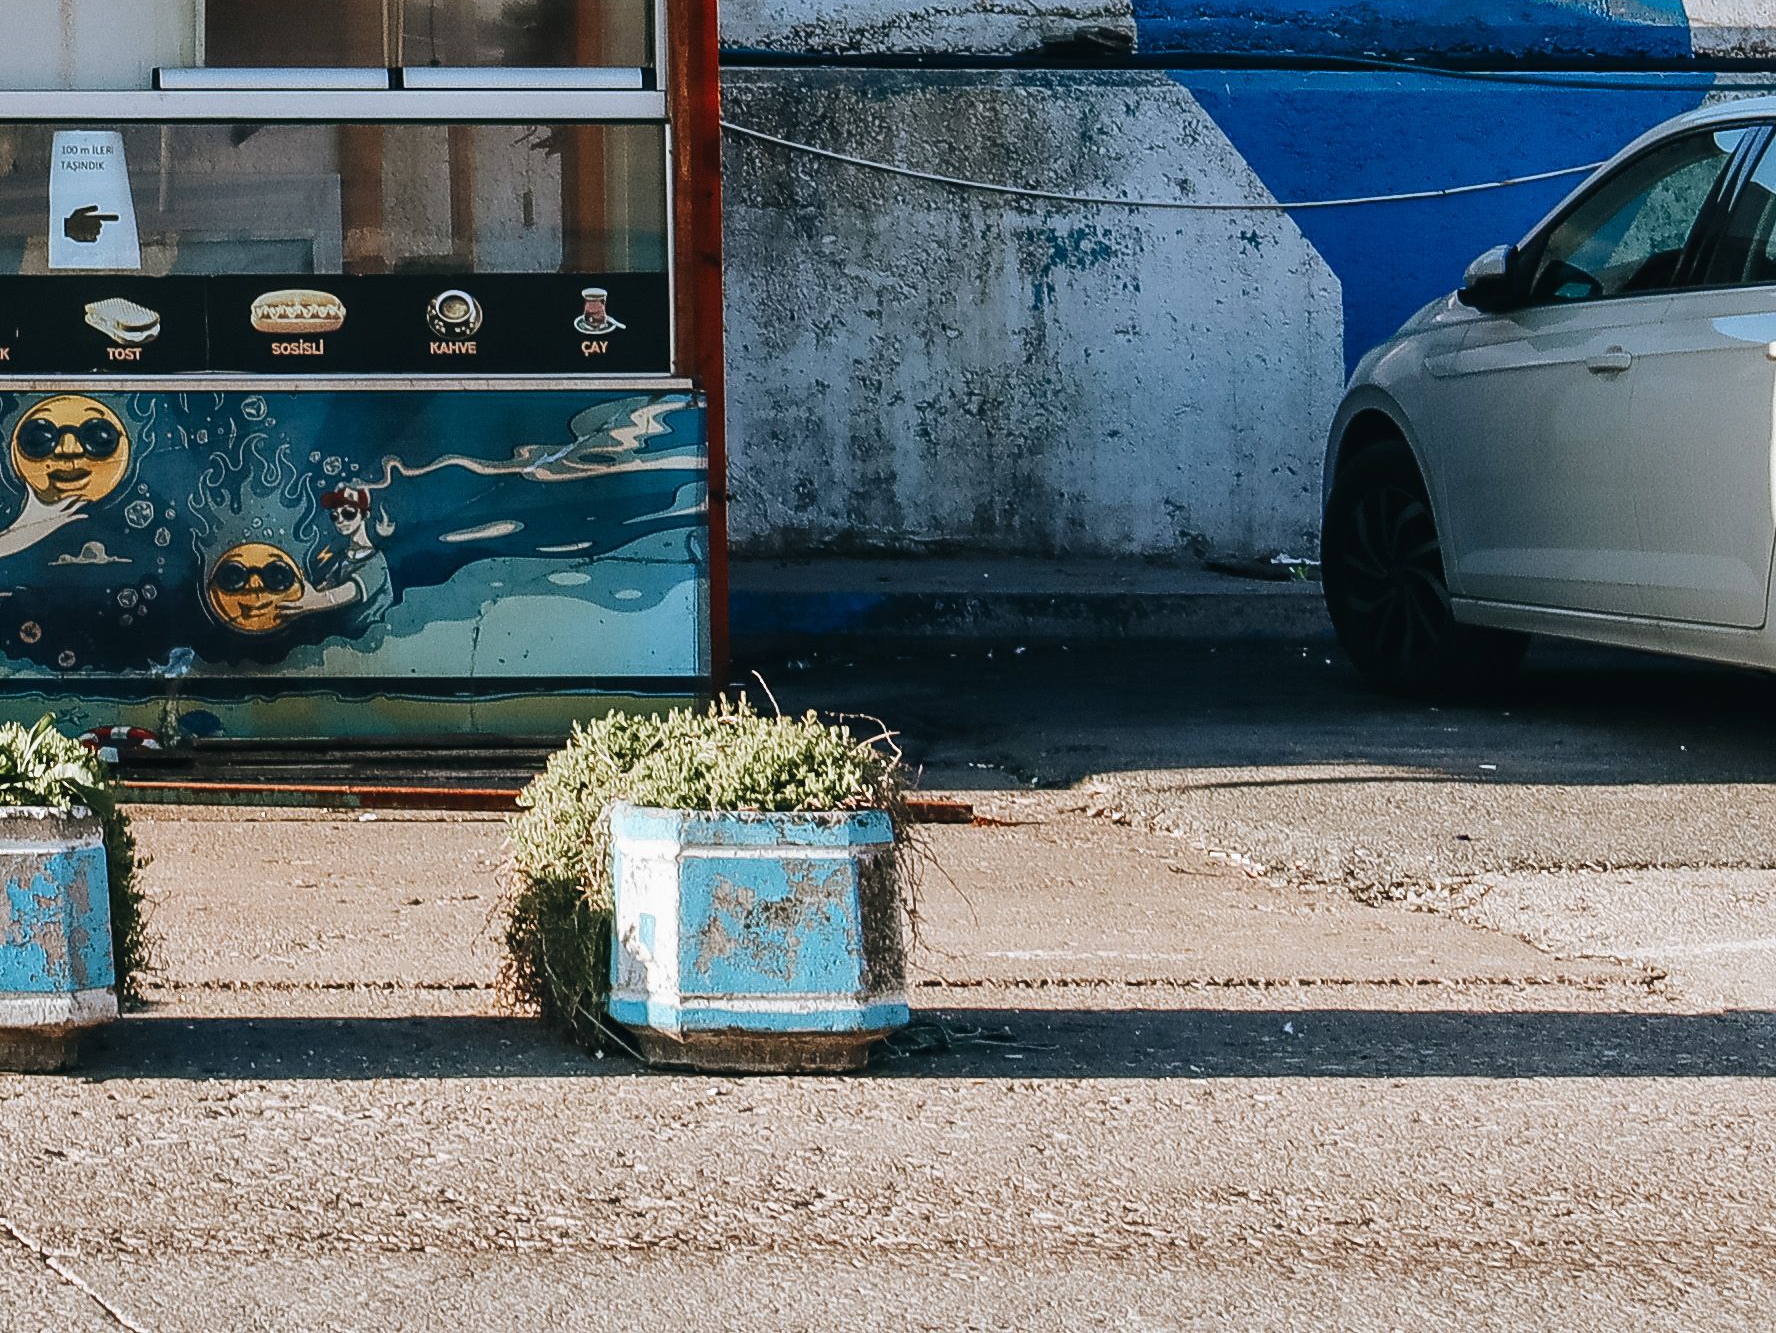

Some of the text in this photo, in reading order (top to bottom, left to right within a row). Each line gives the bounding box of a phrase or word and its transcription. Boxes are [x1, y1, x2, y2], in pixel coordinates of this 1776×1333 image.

[61, 145, 78, 155] 100
[80, 147, 90, 155] m
[60, 161, 105, 172] TAŞINDIK
[106, 347, 143, 361] TOST
[271, 339, 325, 355] SOSİSLİ
[430, 341, 477, 355] KAHVE
[581, 341, 609, 357] ÇAY
